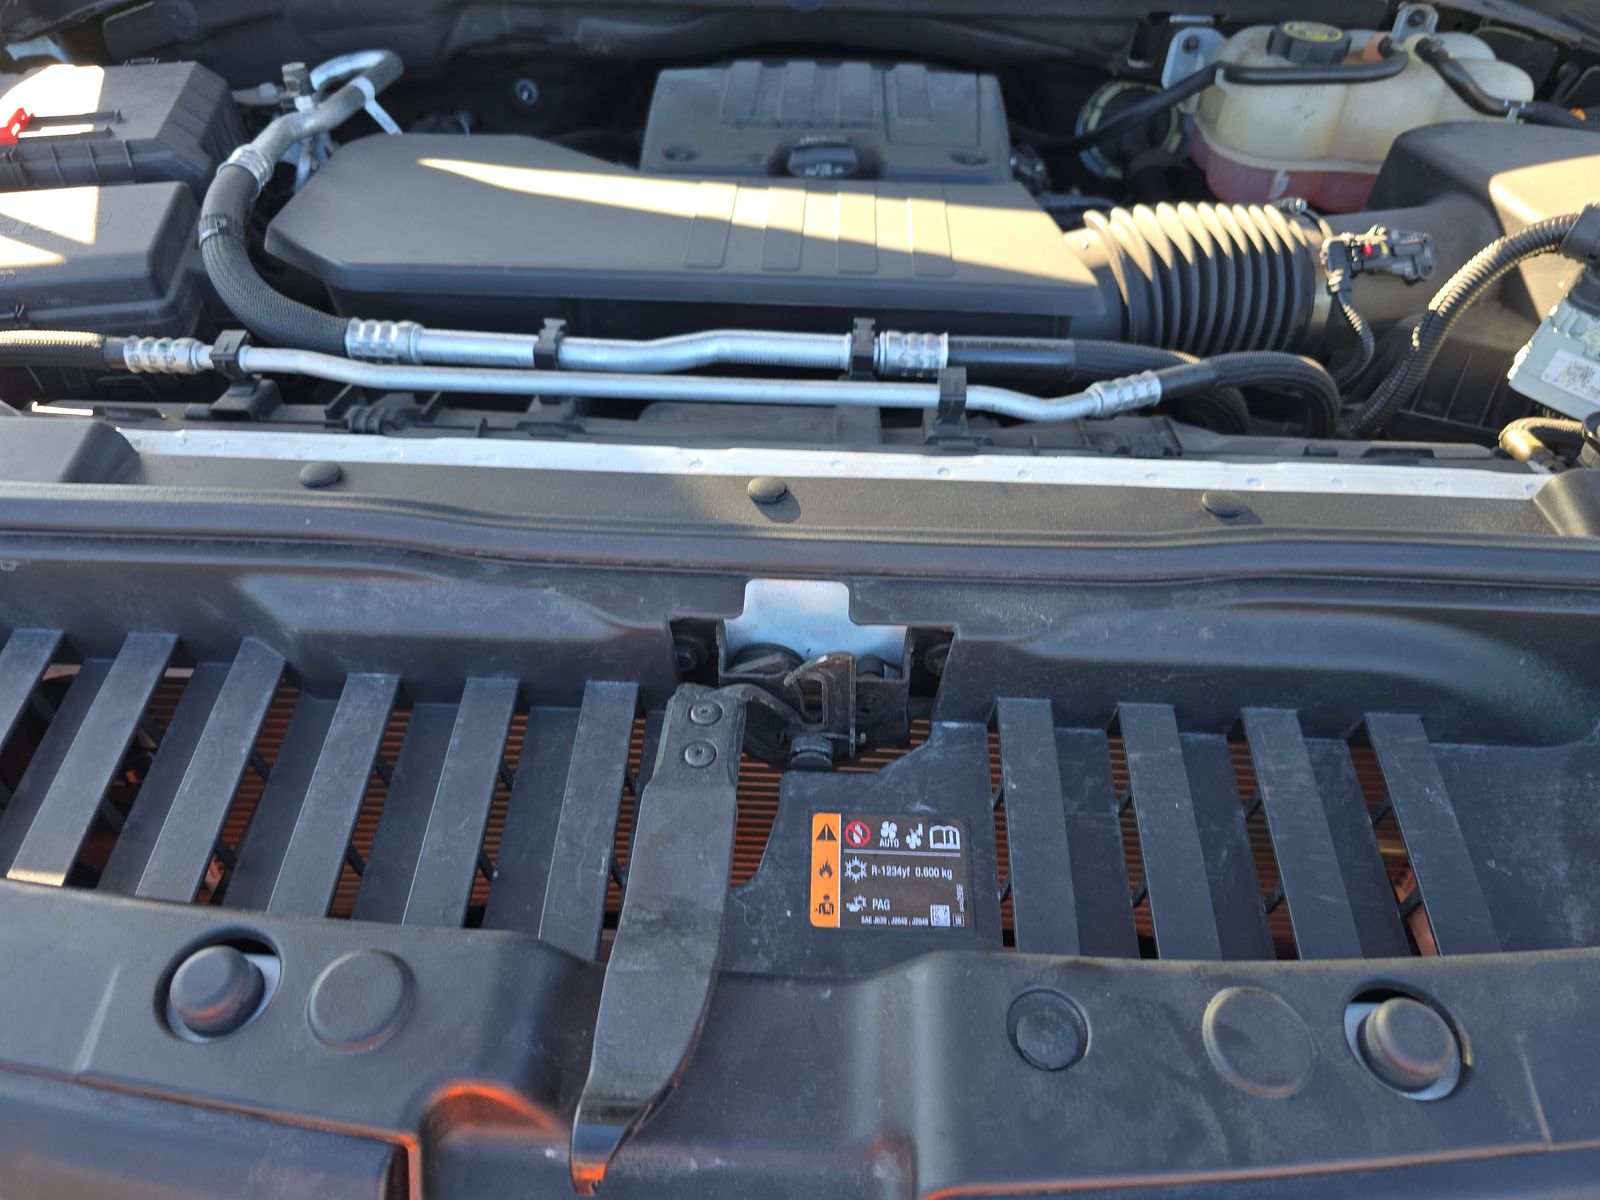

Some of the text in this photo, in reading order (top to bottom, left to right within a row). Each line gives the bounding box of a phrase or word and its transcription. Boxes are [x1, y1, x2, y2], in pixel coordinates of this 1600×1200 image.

[879, 838, 899, 848] AUTO
[871, 864, 953, 881] R-1234yf 0.600 kg
[872, 898, 890, 911] PAG
